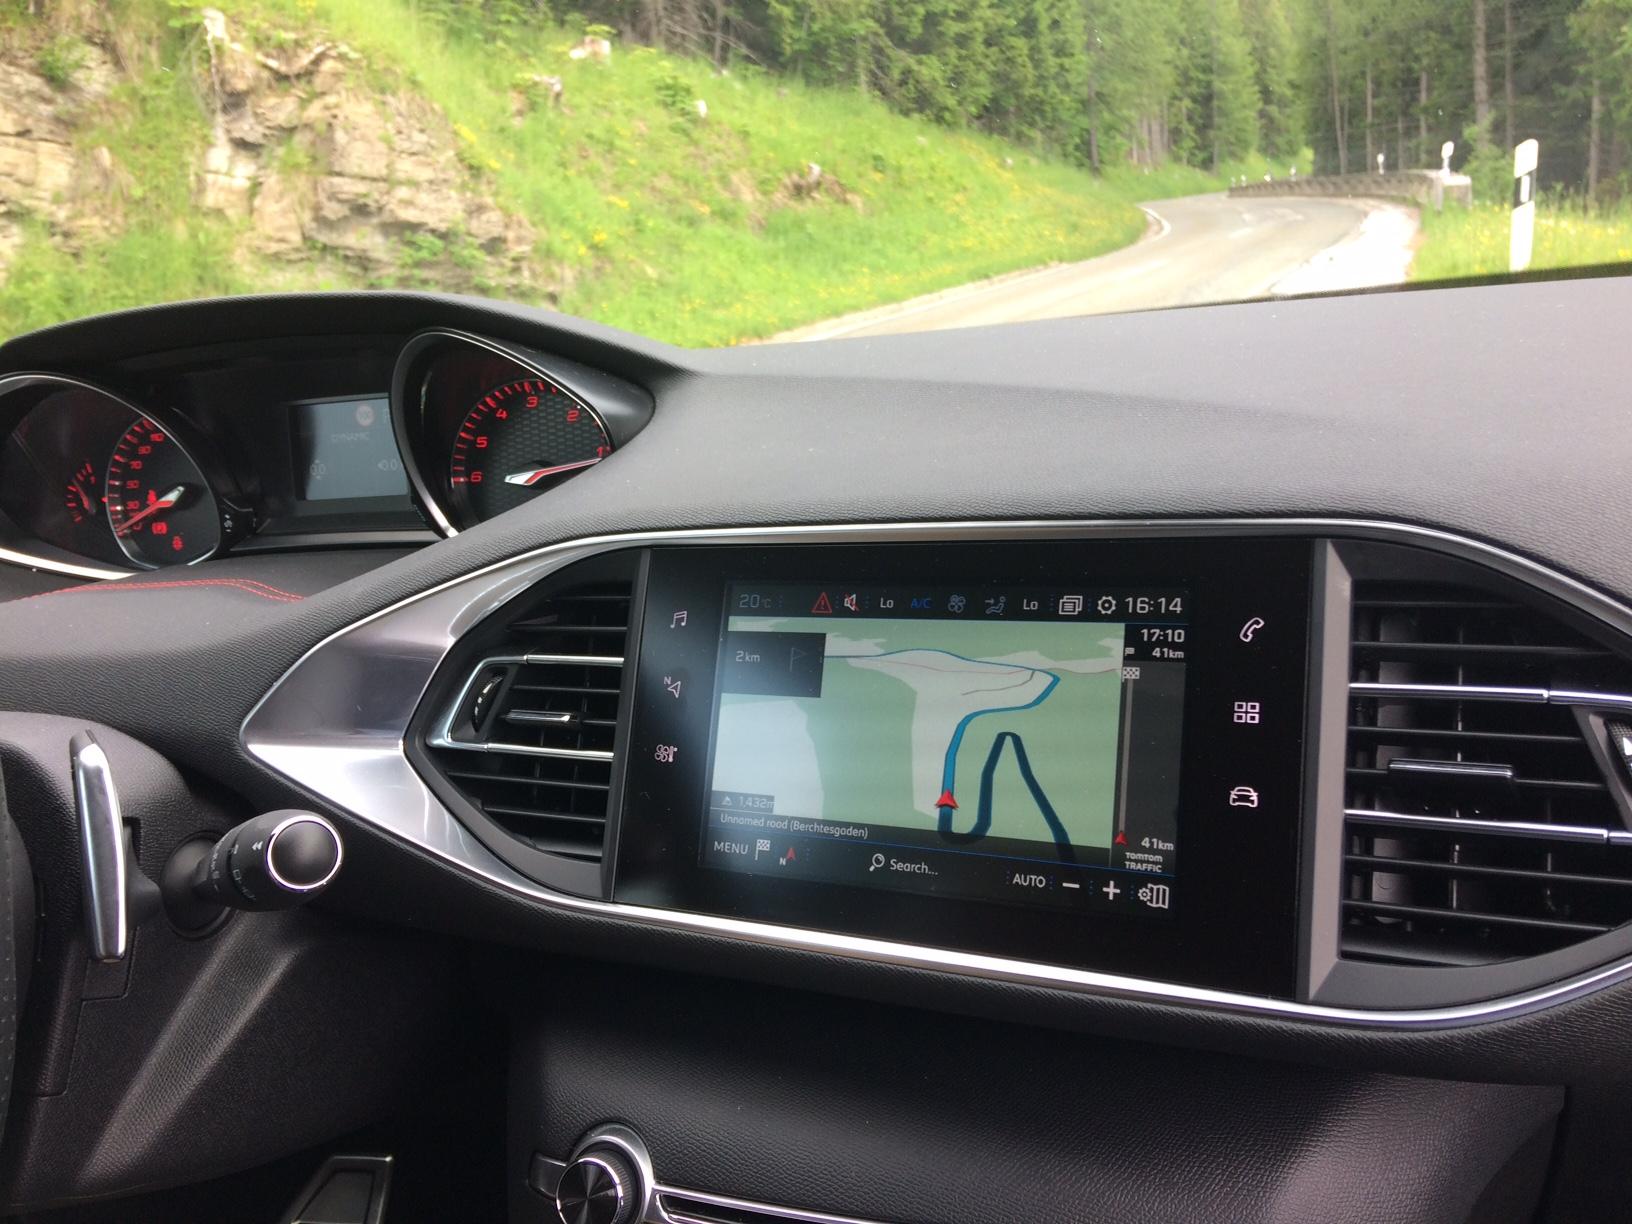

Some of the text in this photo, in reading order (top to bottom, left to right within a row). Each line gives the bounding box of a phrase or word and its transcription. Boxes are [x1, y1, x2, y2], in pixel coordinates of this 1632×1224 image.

[528, 397, 538, 408] 3
[496, 408, 508, 420] 4
[567, 410, 579, 422] 2
[475, 437, 488, 448] 5
[470, 472, 482, 482] 6
[880, 597, 894, 608] Lo
[1023, 598, 1038, 610] Lo
[1125, 597, 1183, 614] 16:14
[1141, 629, 1185, 642] 17:10
[720, 813, 869, 839] Unnamed road (Berchtesgaden)
[714, 841, 749, 855] MENU
[1125, 861, 1163, 873] TRAFFIC
[1012, 873, 1046, 888] AUTO
